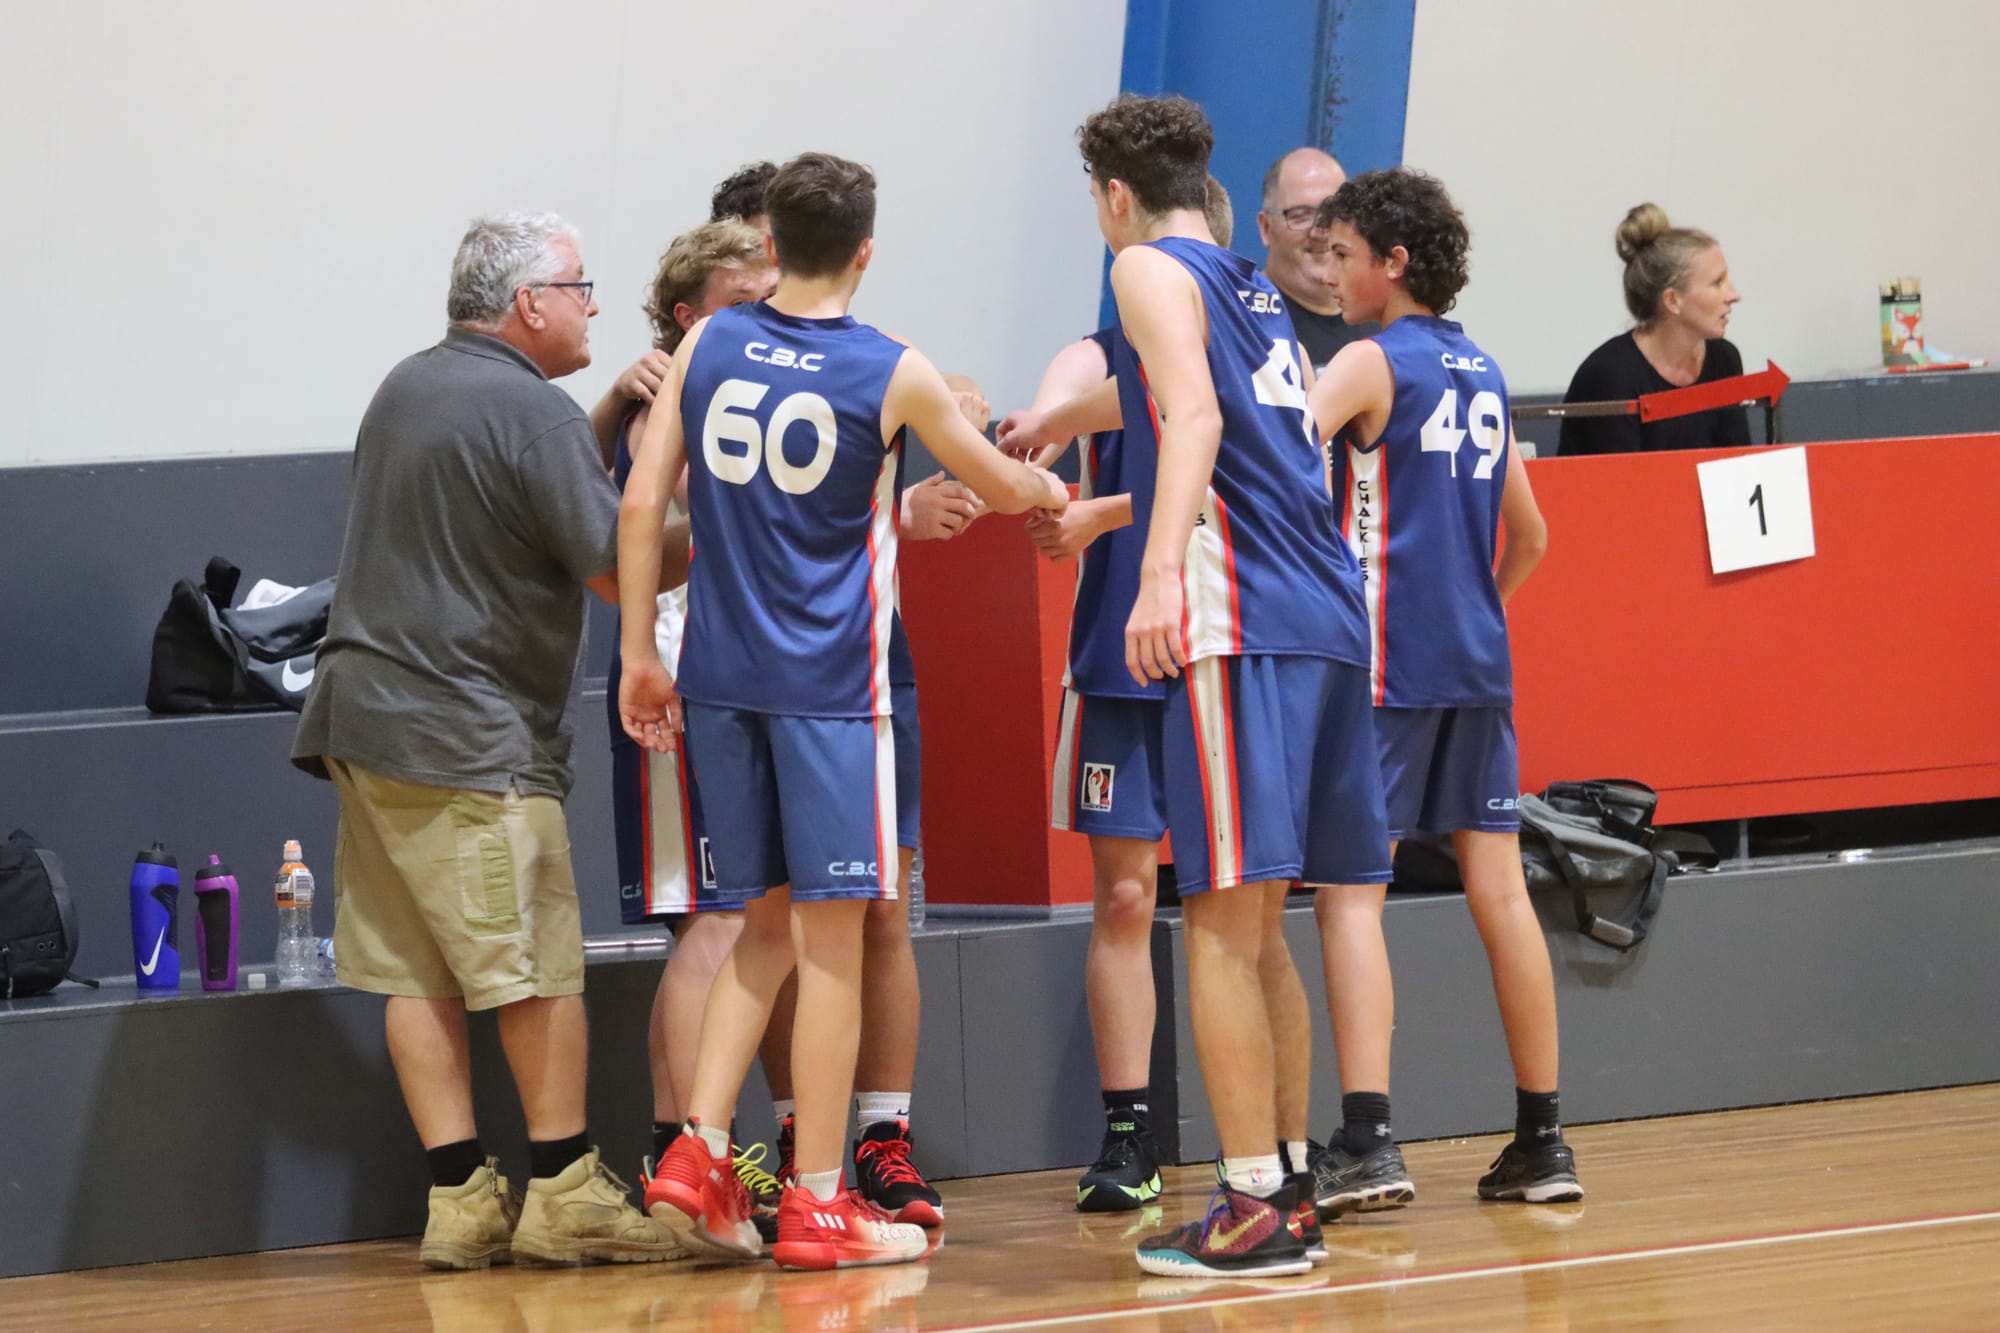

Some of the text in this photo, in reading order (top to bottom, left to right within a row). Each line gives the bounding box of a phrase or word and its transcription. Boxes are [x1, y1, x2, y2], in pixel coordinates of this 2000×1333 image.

[744, 341, 826, 372] C.B.C
[1441, 352, 1488, 372] C.B.C
[702, 378, 838, 495] 60
[1420, 388, 1505, 480] 49
[1749, 484, 1767, 536] 1
